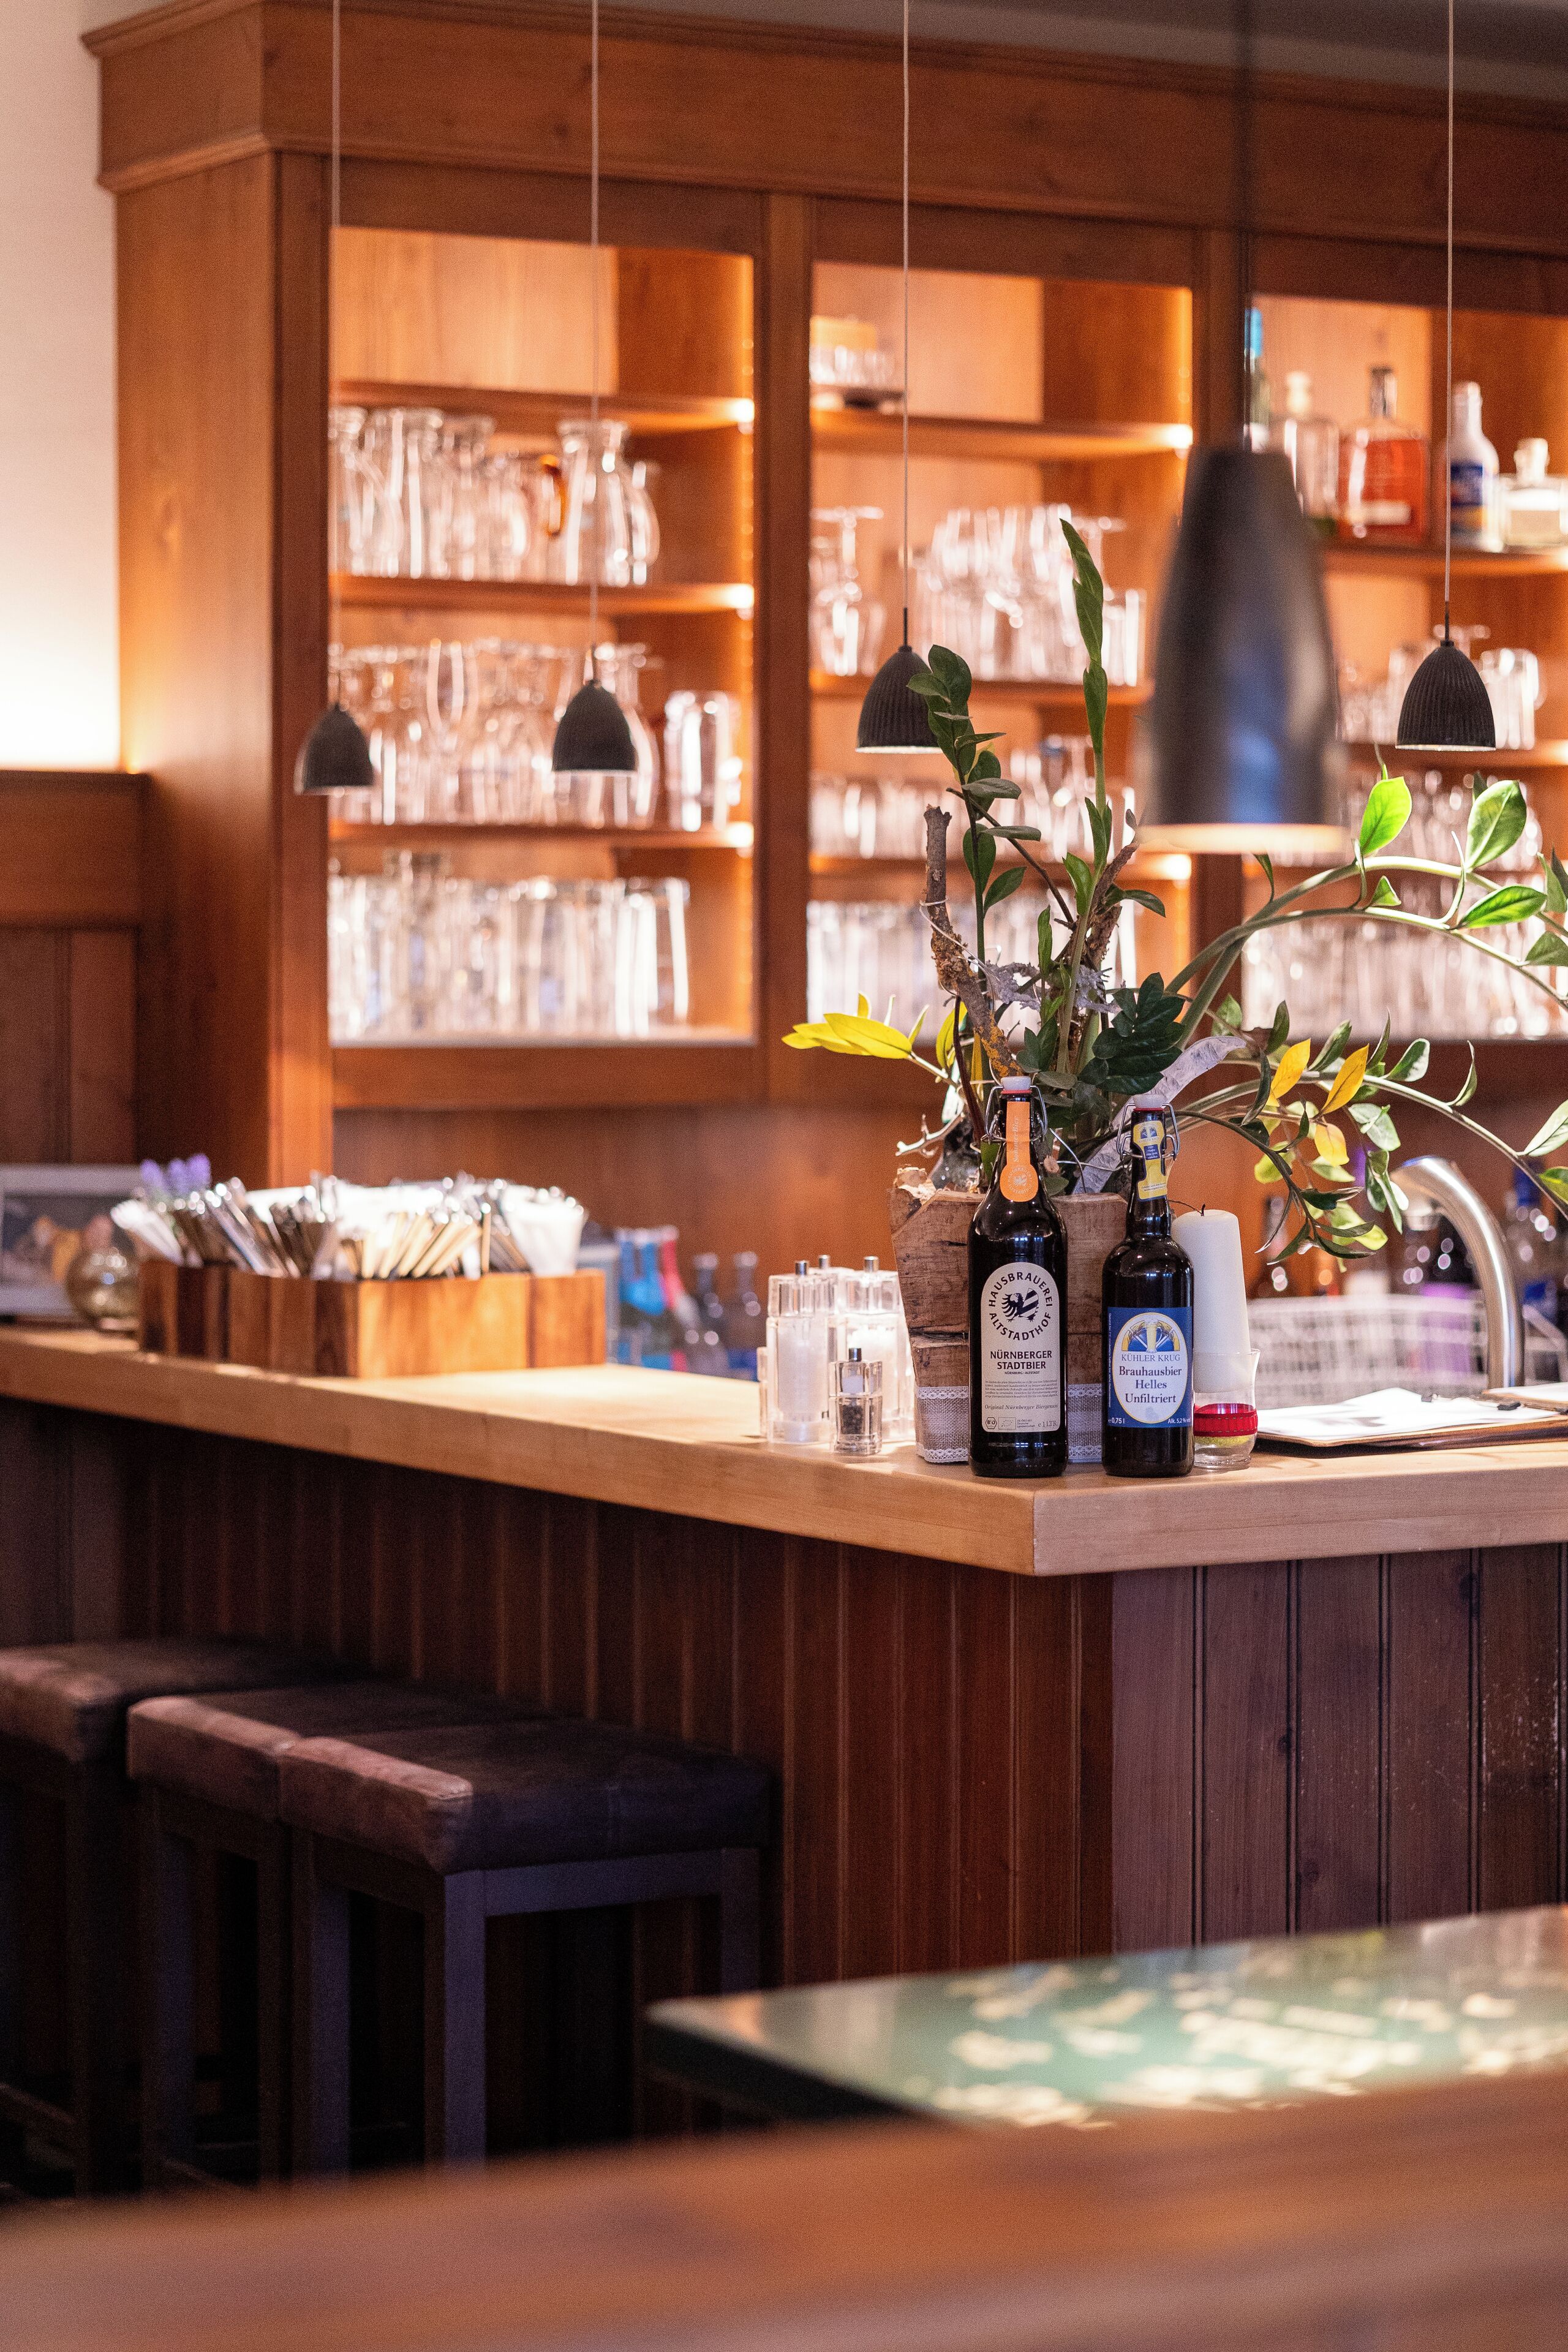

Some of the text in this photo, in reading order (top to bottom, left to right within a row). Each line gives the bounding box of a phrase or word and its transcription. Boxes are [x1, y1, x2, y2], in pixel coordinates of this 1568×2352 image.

[989, 1272, 1053, 1307] HAUSBRAUEREI
[989, 1312, 1052, 1341] ALTSTADTHOF
[990, 1349, 1052, 1359] NÜRNBERGER
[1121, 1353, 1155, 1362] KÜHLER
[997, 1361, 1046, 1370] STADTBIER
[1119, 1366, 1182, 1376] Brauhausbier
[1136, 1380, 1167, 1389] Helles
[1125, 1393, 1177, 1403] Unfiltriert
